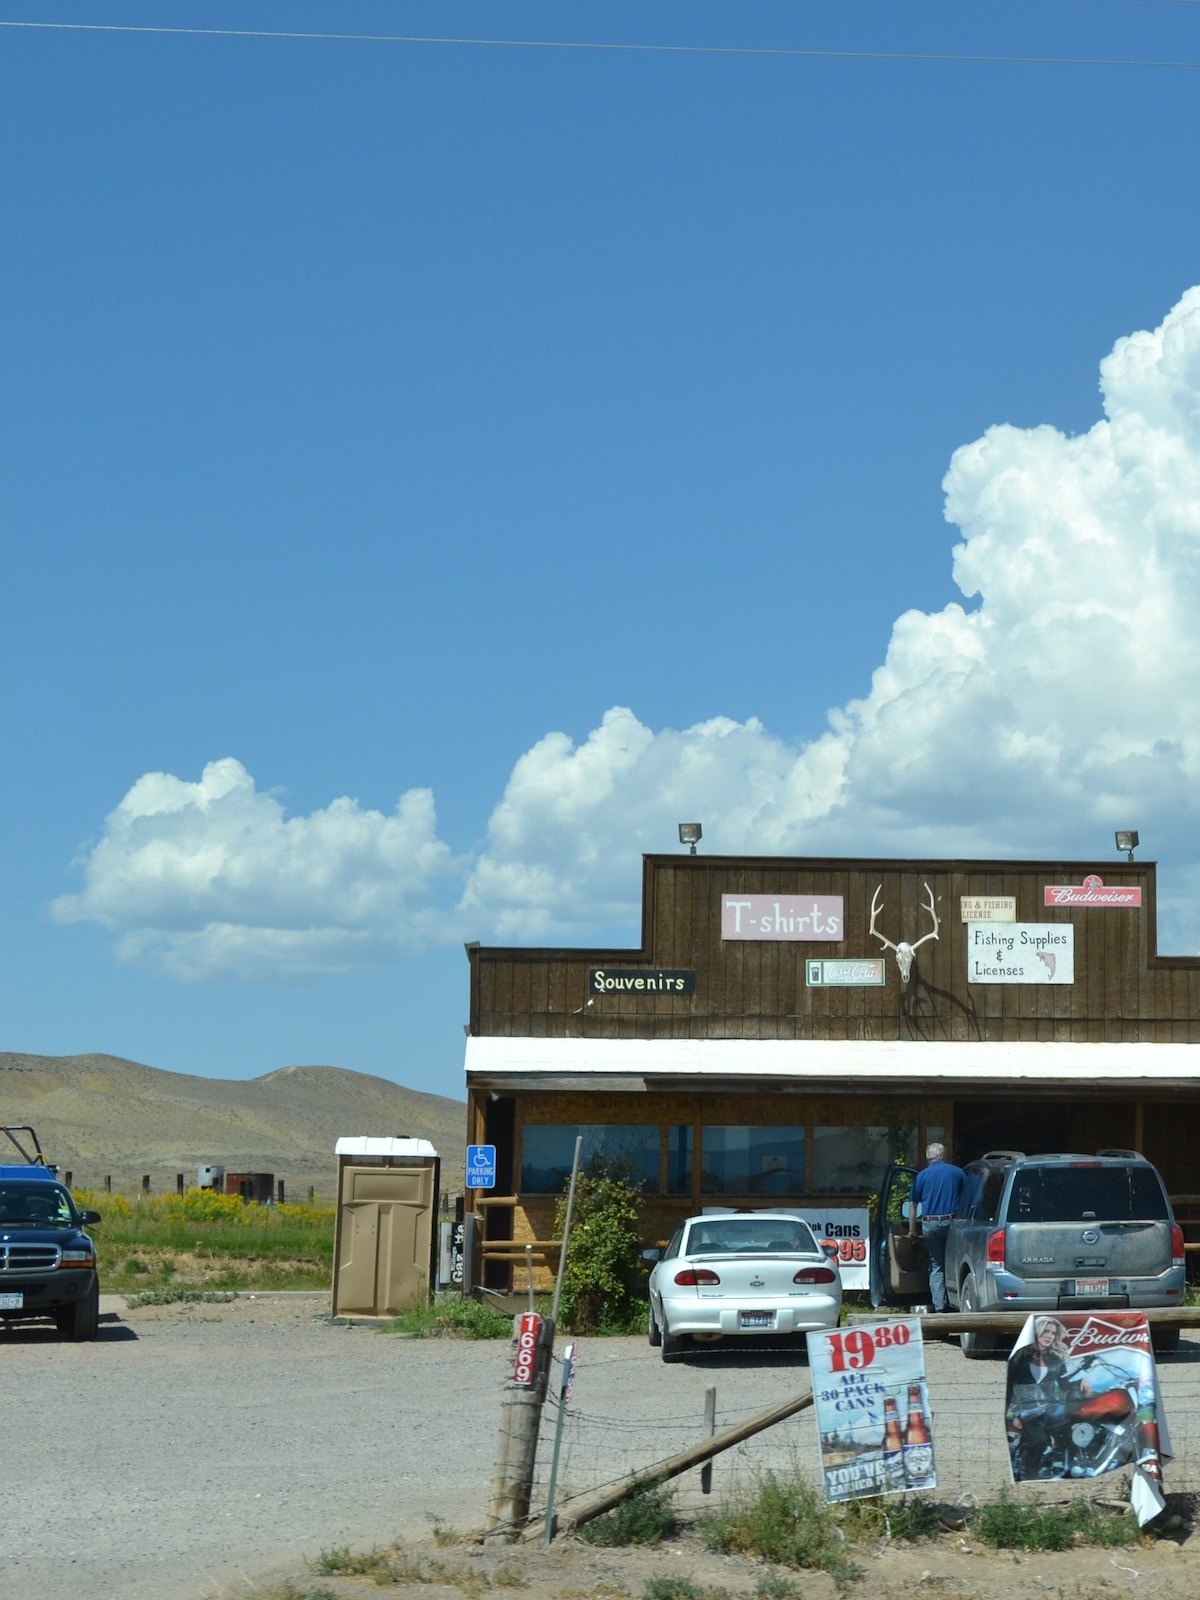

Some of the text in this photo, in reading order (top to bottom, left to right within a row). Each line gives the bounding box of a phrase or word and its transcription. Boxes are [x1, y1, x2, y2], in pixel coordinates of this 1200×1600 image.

[1051, 888, 1135, 904] Budweiser
[984, 901, 1013, 909] FISHING
[726, 901, 840, 934] T-shirts
[962, 911, 992, 919] LICENSE
[975, 930, 1067, 950] Fishing Supplies
[975, 961, 1024, 976] Licenses
[594, 971, 685, 991] Souvenirs
[468, 1167, 493, 1176] PARKING
[472, 1177, 489, 1185] ONLY
[825, 1222, 860, 1237] Cans
[517, 1316, 535, 1382] 1669
[840, 1374, 870, 1386] ALL
[821, 1382, 886, 1401] 30 PACK
[835, 1396, 876, 1412] CANS
